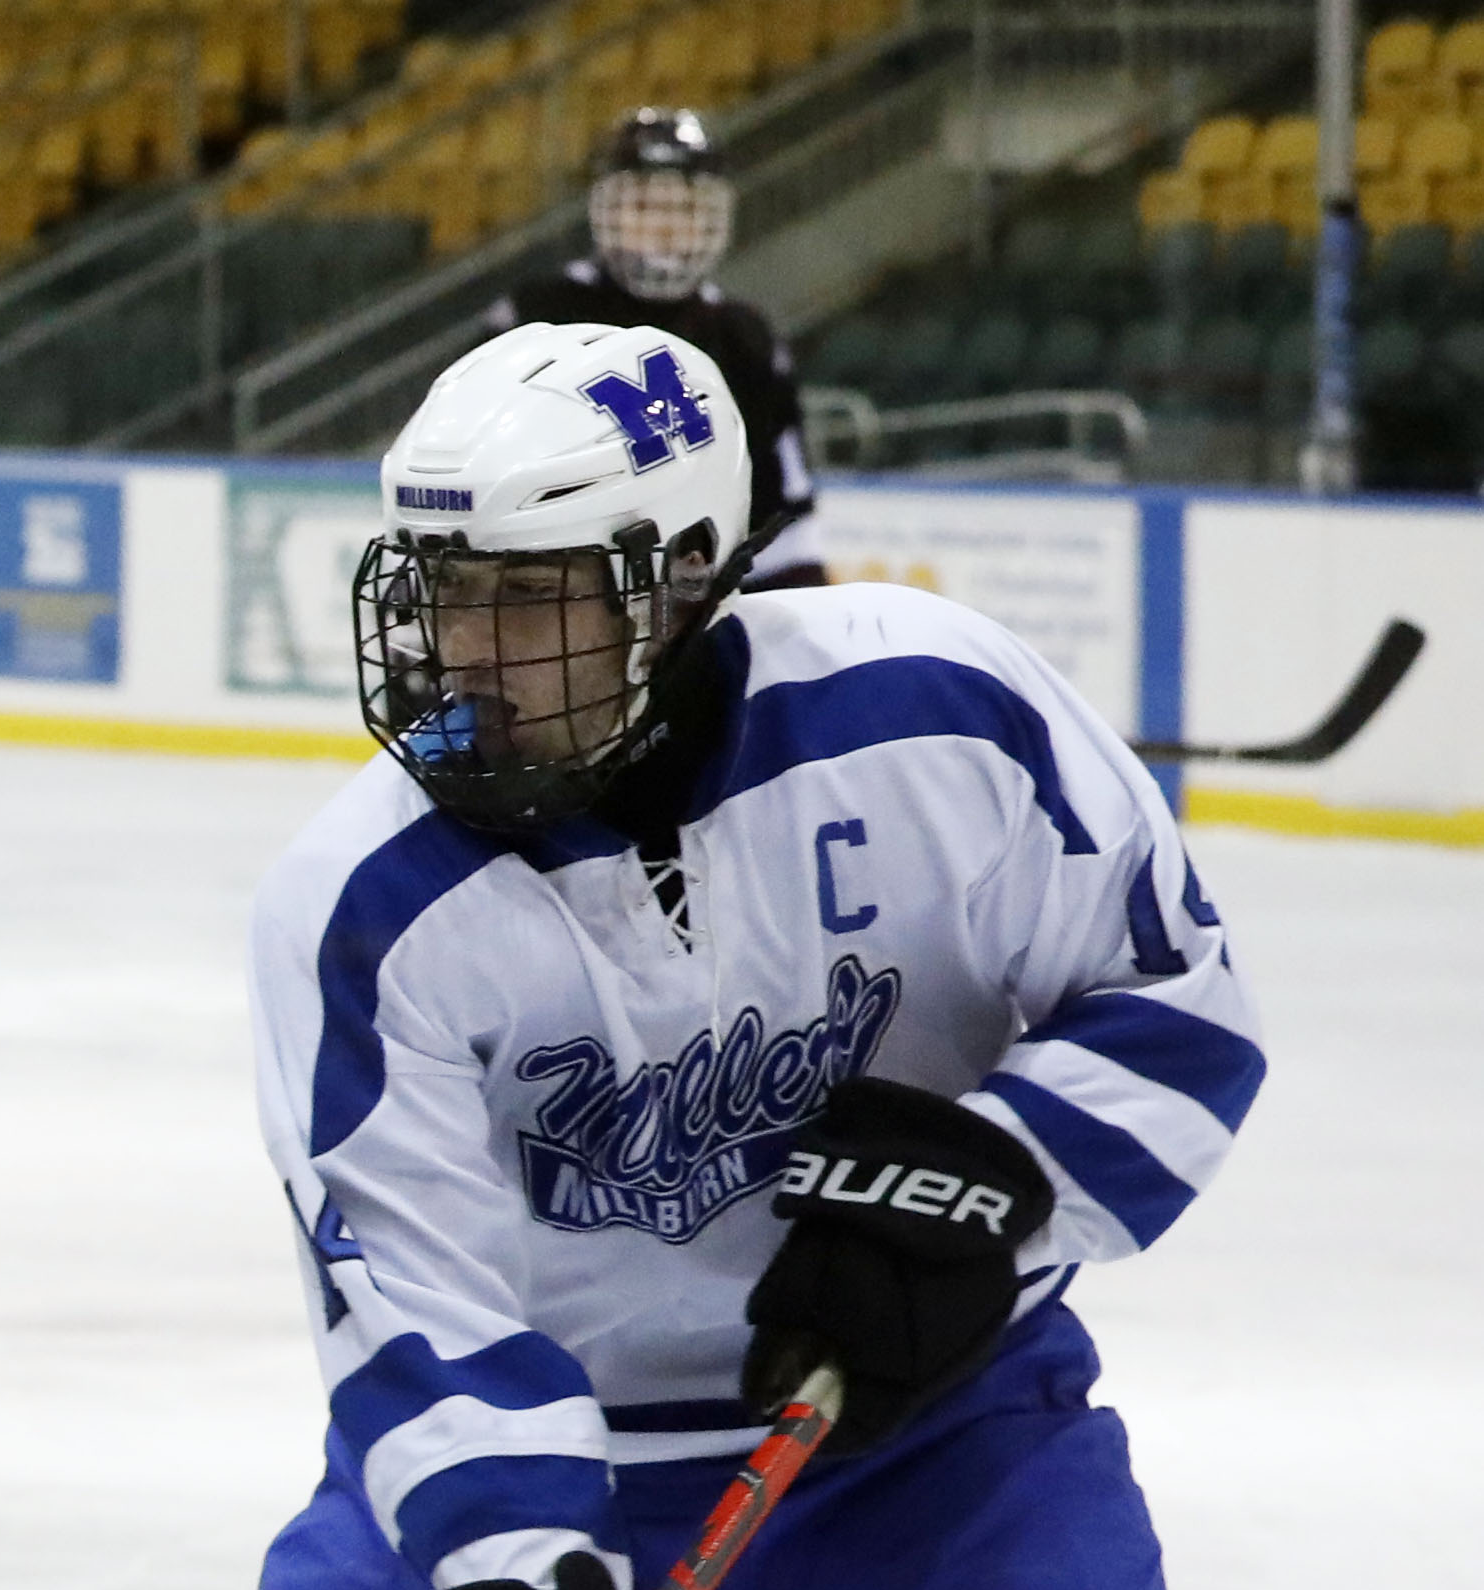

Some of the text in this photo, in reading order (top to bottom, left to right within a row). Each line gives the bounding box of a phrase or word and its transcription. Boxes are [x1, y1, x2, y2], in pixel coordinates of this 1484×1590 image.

[577, 344, 715, 475] M
[395, 485, 473, 512] MILLBURN
[815, 818, 879, 934] C
[779, 1150, 1014, 1236] AUER
